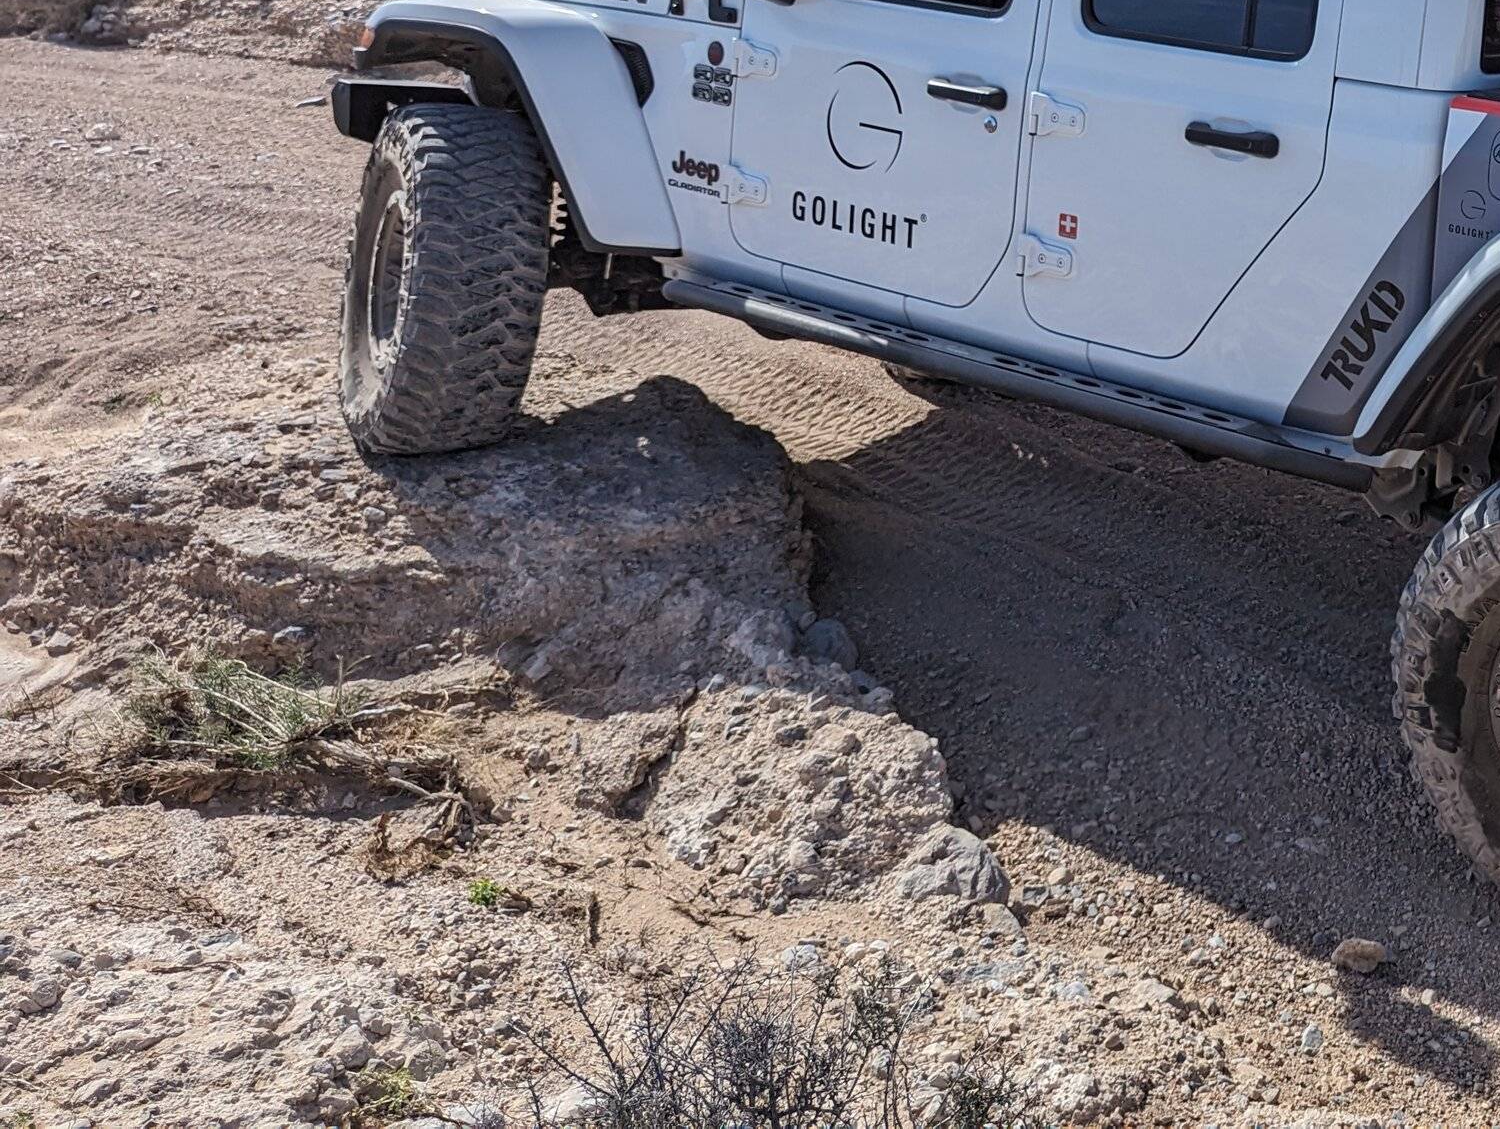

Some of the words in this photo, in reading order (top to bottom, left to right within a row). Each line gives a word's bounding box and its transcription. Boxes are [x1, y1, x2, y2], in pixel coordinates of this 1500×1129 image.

[672, 150, 720, 186] Jeep
[668, 178, 721, 199] GLADIATOR
[1320, 280, 1406, 391] TRUKD
